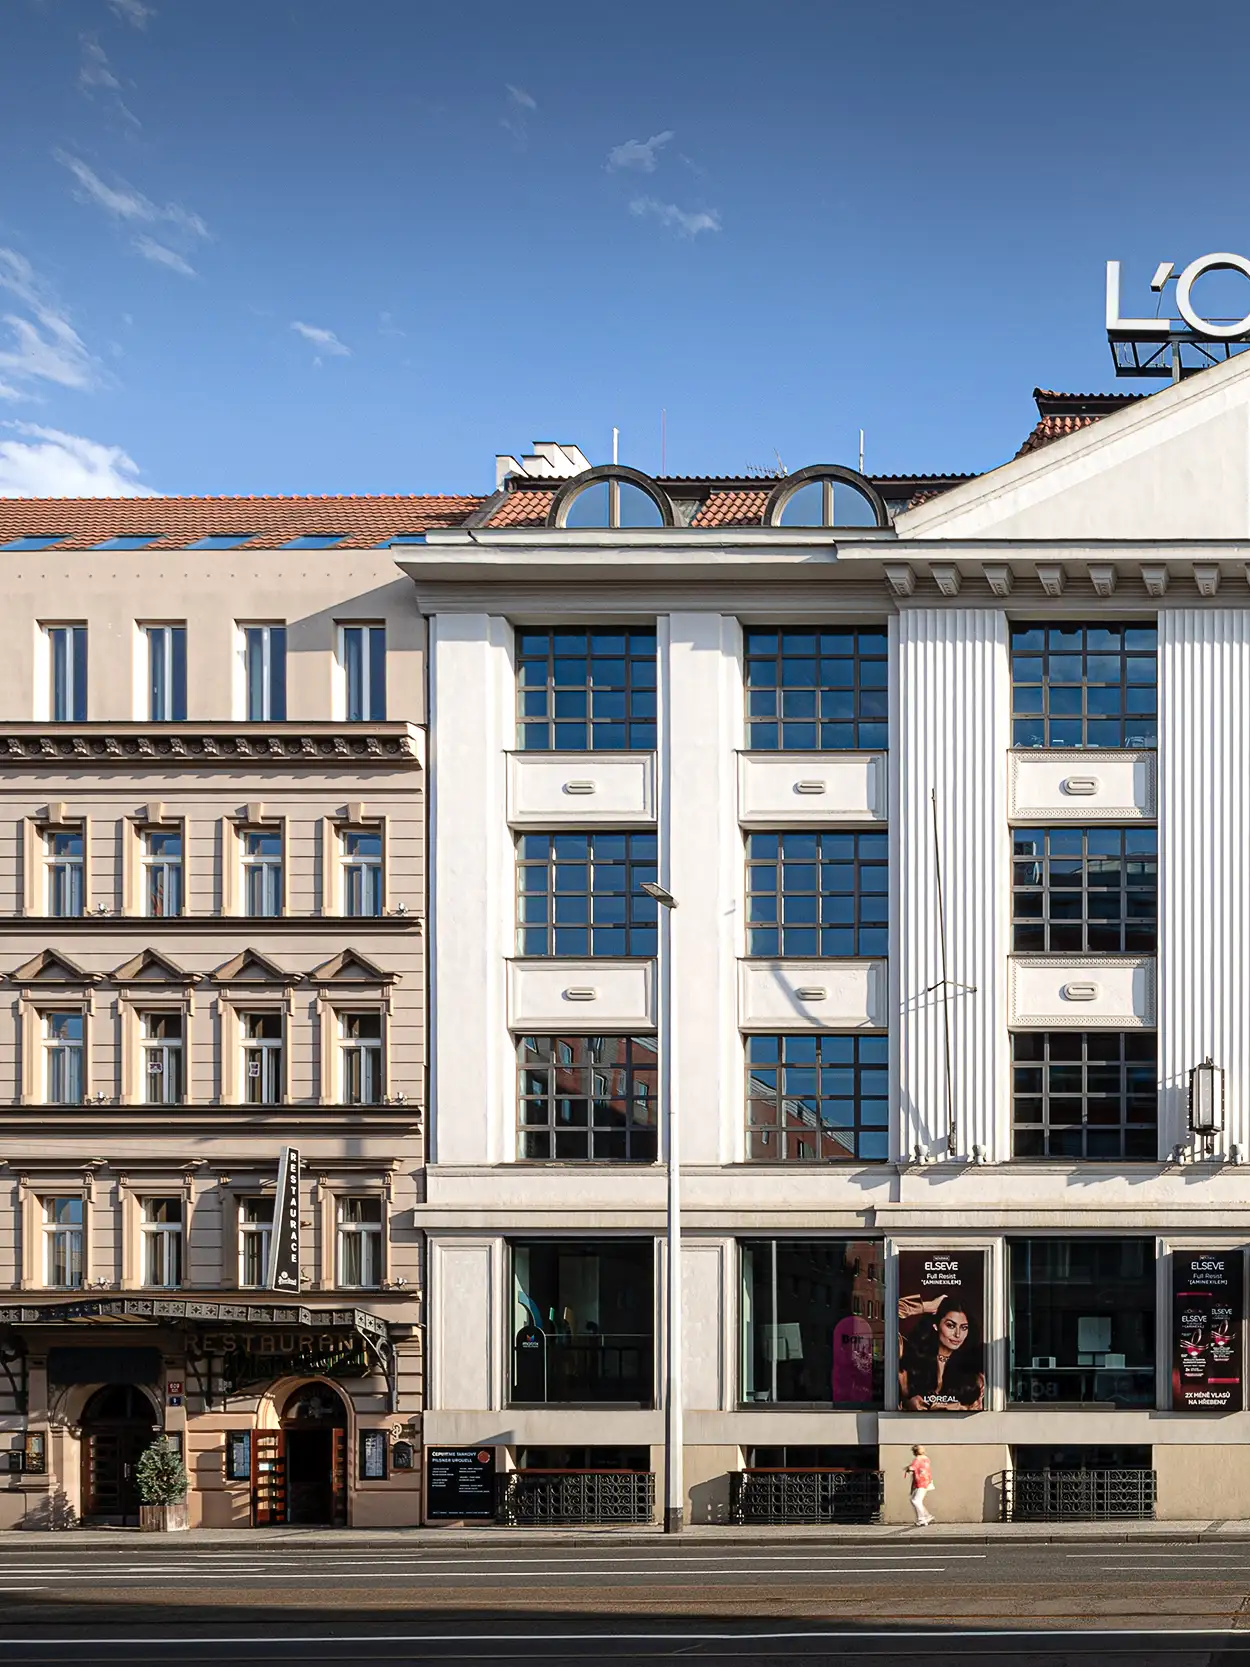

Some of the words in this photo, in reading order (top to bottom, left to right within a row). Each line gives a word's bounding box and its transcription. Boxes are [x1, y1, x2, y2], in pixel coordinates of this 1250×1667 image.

[290, 1152, 298, 1263] RESTAURACE
[924, 1261, 958, 1270] ELSEVE
[1191, 1261, 1225, 1270] ELSEVE
[1181, 1315, 1207, 1323] ELSEVE
